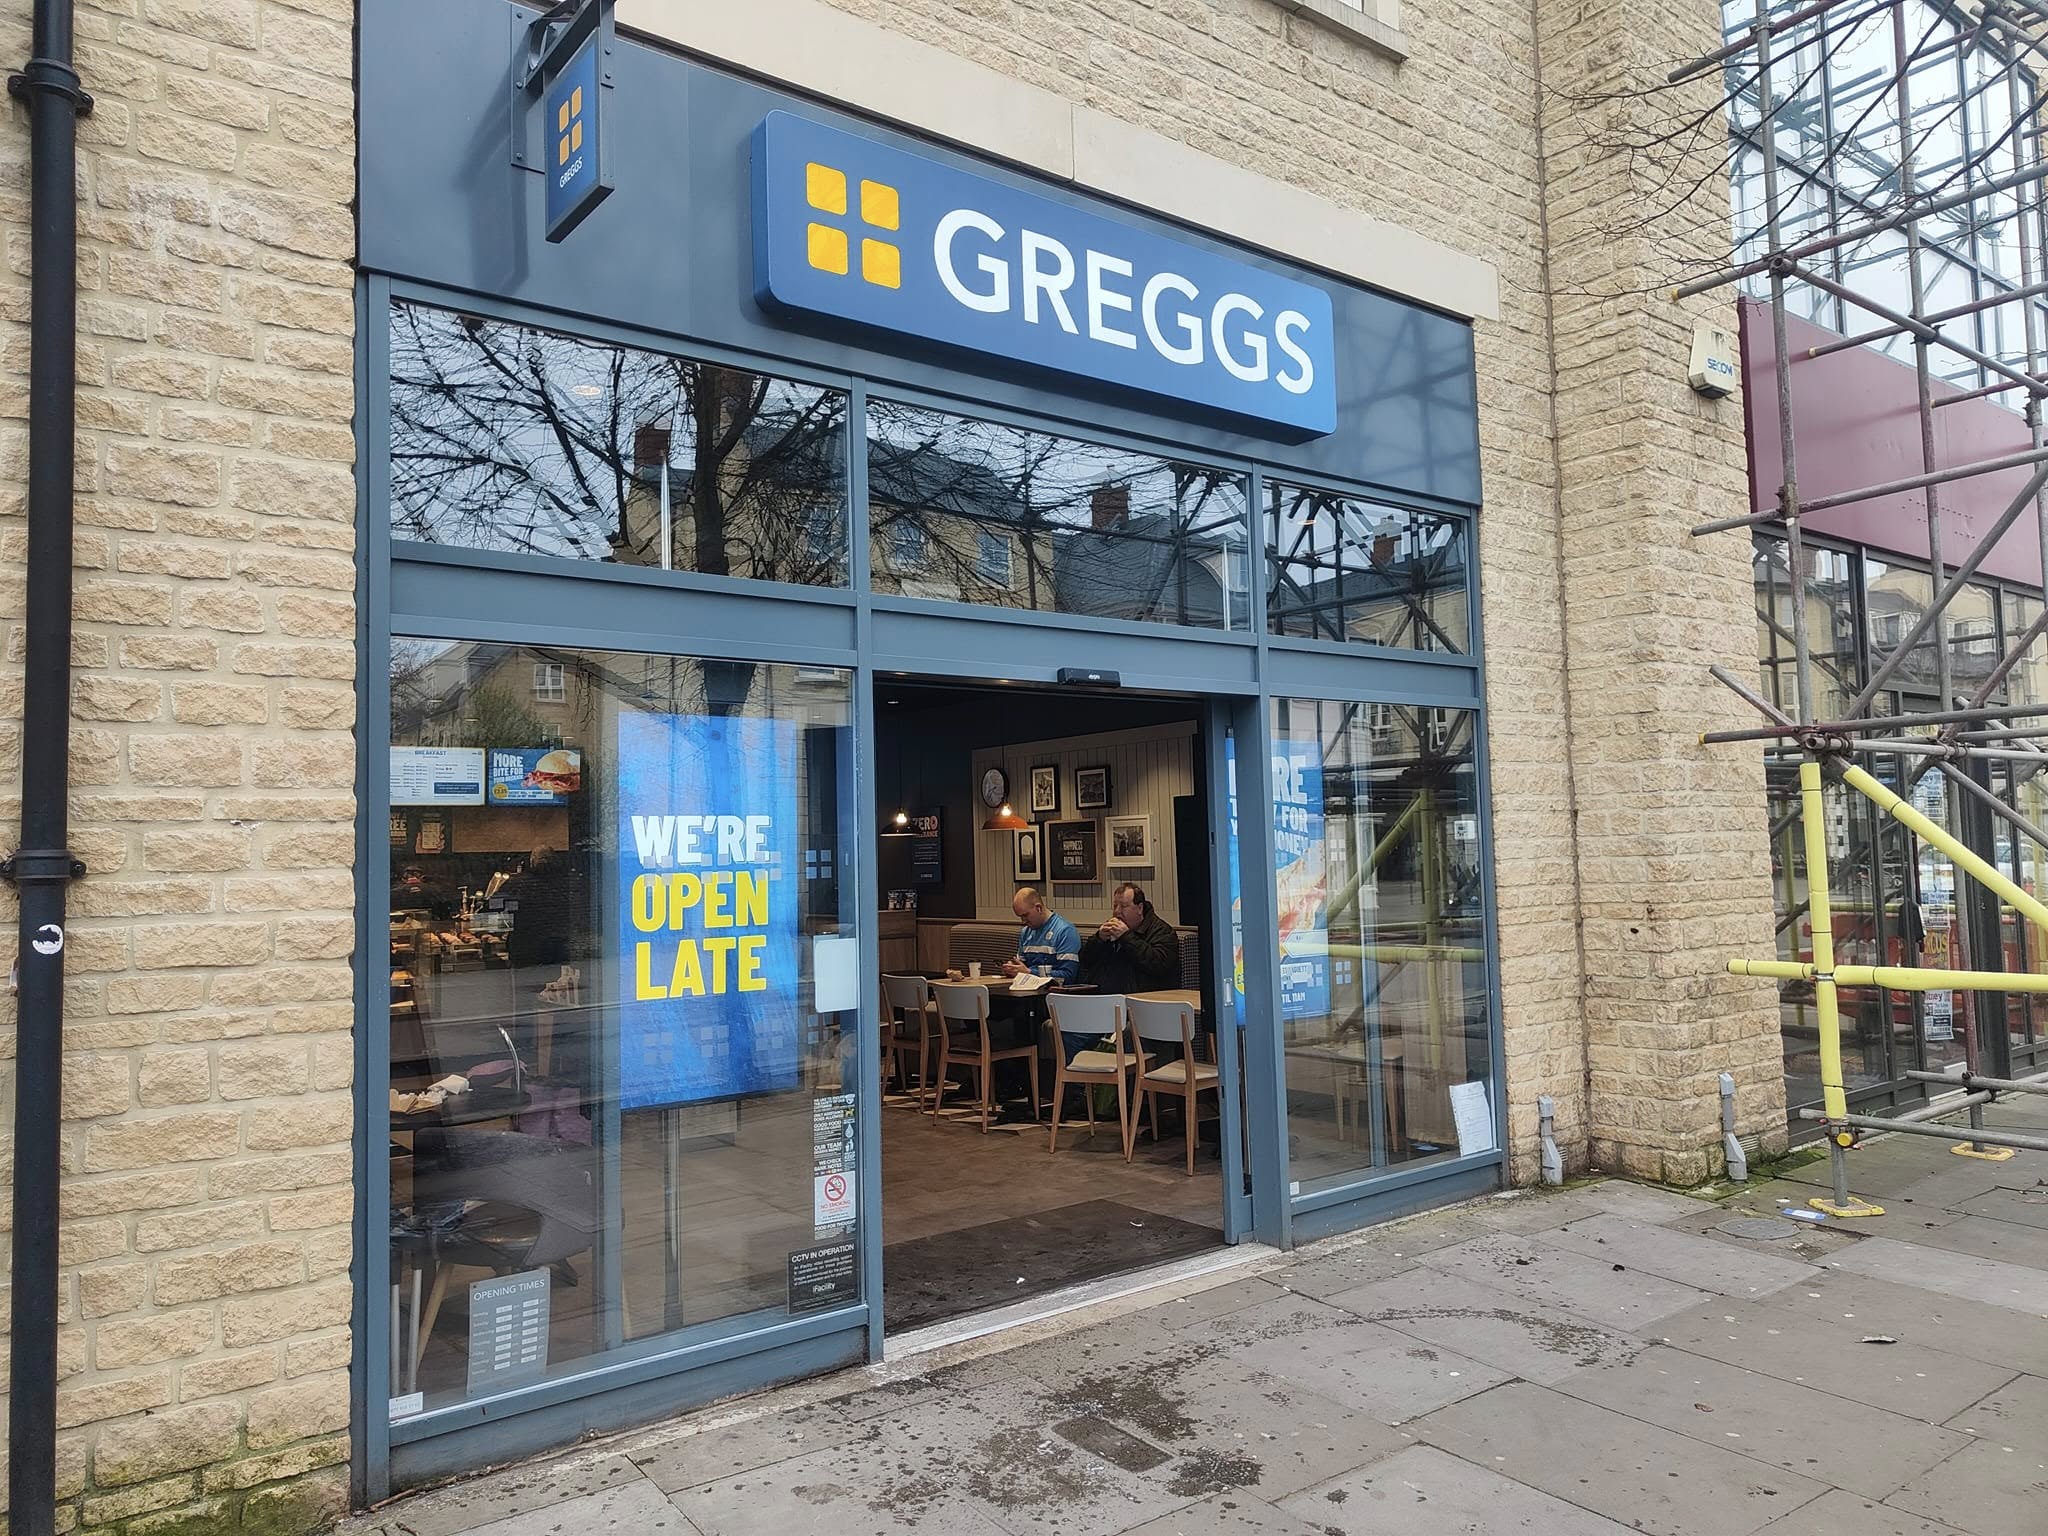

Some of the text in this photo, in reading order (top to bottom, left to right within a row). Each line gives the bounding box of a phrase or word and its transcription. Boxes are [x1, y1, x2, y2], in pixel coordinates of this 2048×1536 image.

[559, 156, 583, 188] GREGGS
[933, 208, 1314, 394] GREGGS
[493, 752, 524, 768] MORE
[510, 767, 524, 776] FOR
[1281, 805, 1309, 834] FOR
[631, 815, 772, 867] WE'RE
[1274, 829, 1309, 856] ONEY
[631, 870, 769, 933] OPEN
[636, 935, 767, 1001] LATE
[791, 1253, 810, 1263] CCTV
[810, 1251, 818, 1259] IN
[818, 1243, 855, 1257] OPERATION
[473, 1278, 545, 1302] OPENING TIMES
